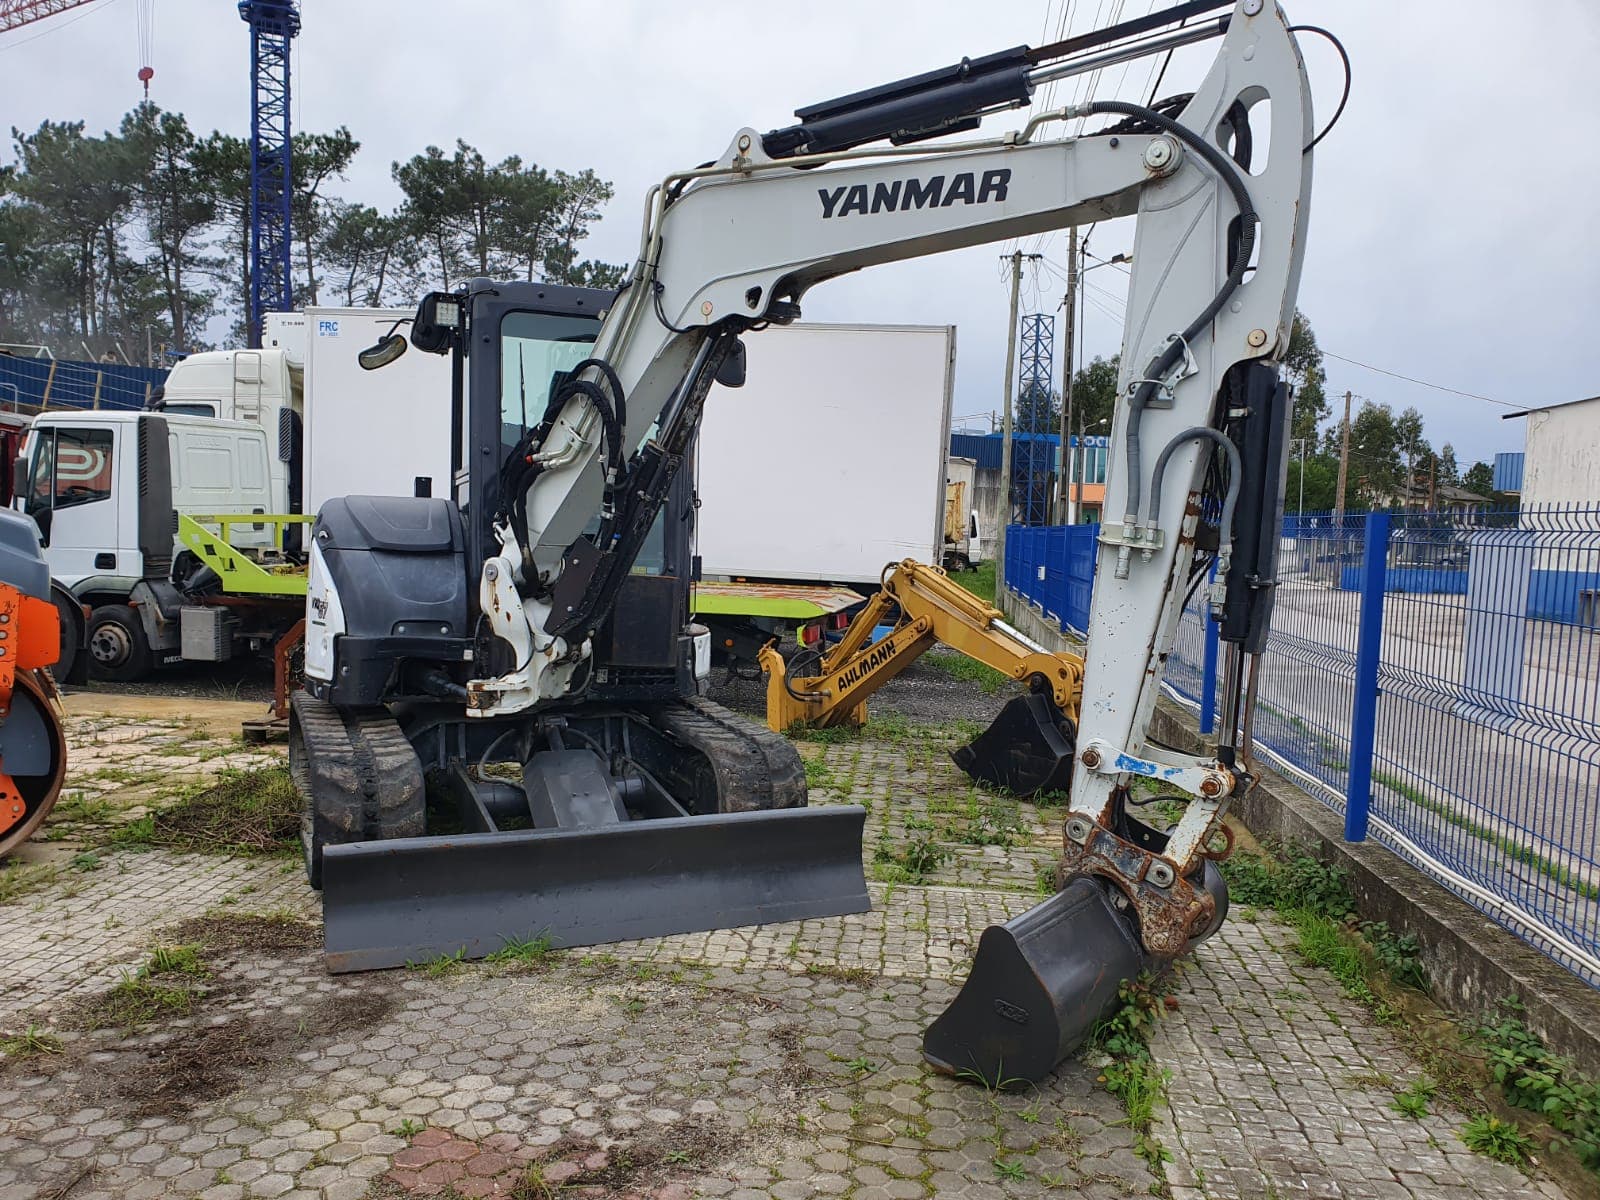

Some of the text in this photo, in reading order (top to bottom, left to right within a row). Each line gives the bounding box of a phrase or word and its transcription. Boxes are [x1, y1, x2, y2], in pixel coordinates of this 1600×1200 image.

[818, 168, 1012, 219] YANMAR
[319, 321, 339, 332] FRC
[838, 640, 896, 693] AHLMANN
